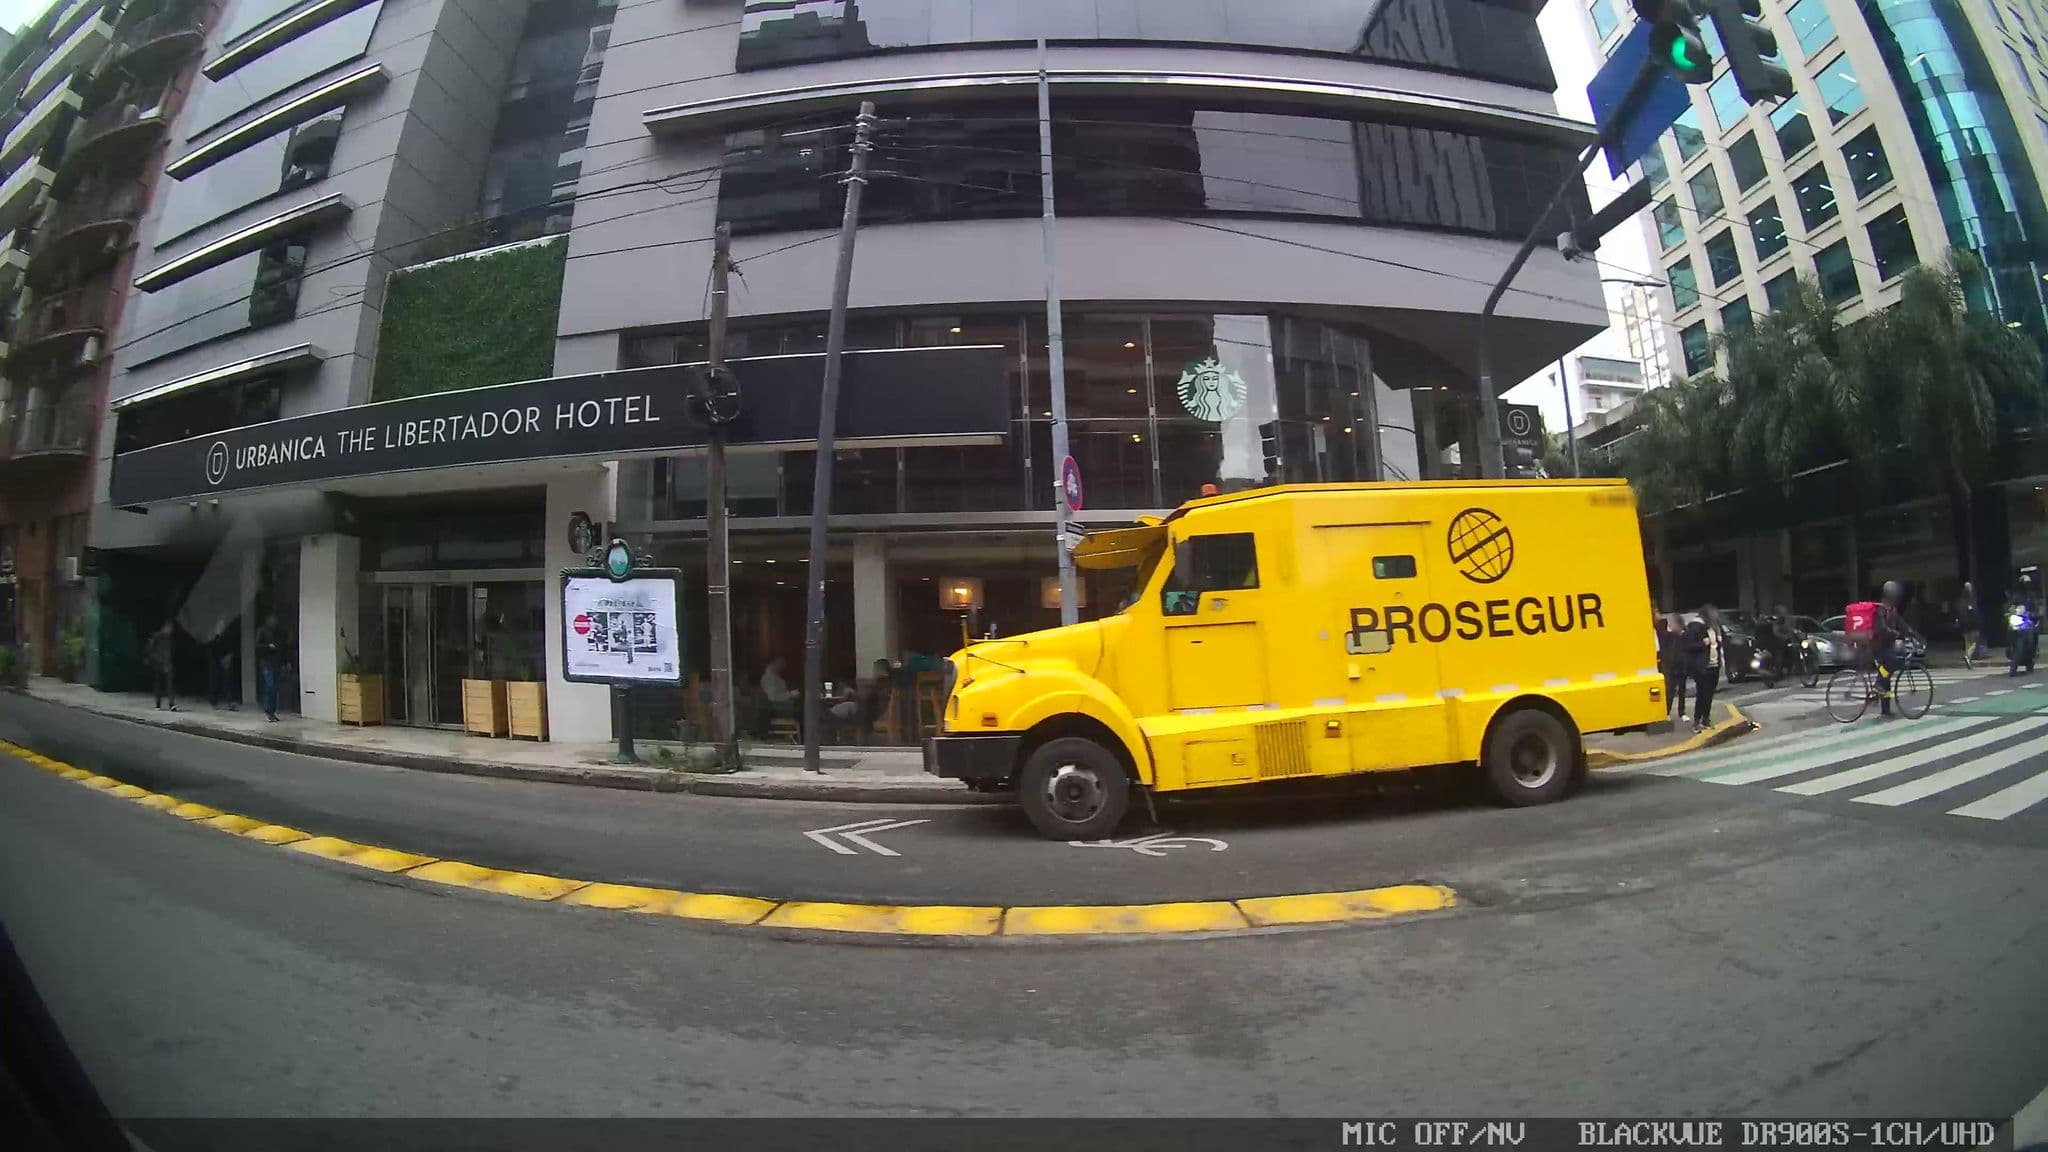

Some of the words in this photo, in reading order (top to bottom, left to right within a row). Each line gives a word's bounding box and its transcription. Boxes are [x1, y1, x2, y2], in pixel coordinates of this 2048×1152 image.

[235, 435, 326, 470] URBANICA
[337, 426, 376, 455] THE
[385, 406, 541, 449] LIBERTADOR
[555, 394, 661, 431] HOTEL
[1349, 592, 1604, 647] PROSEGUR
